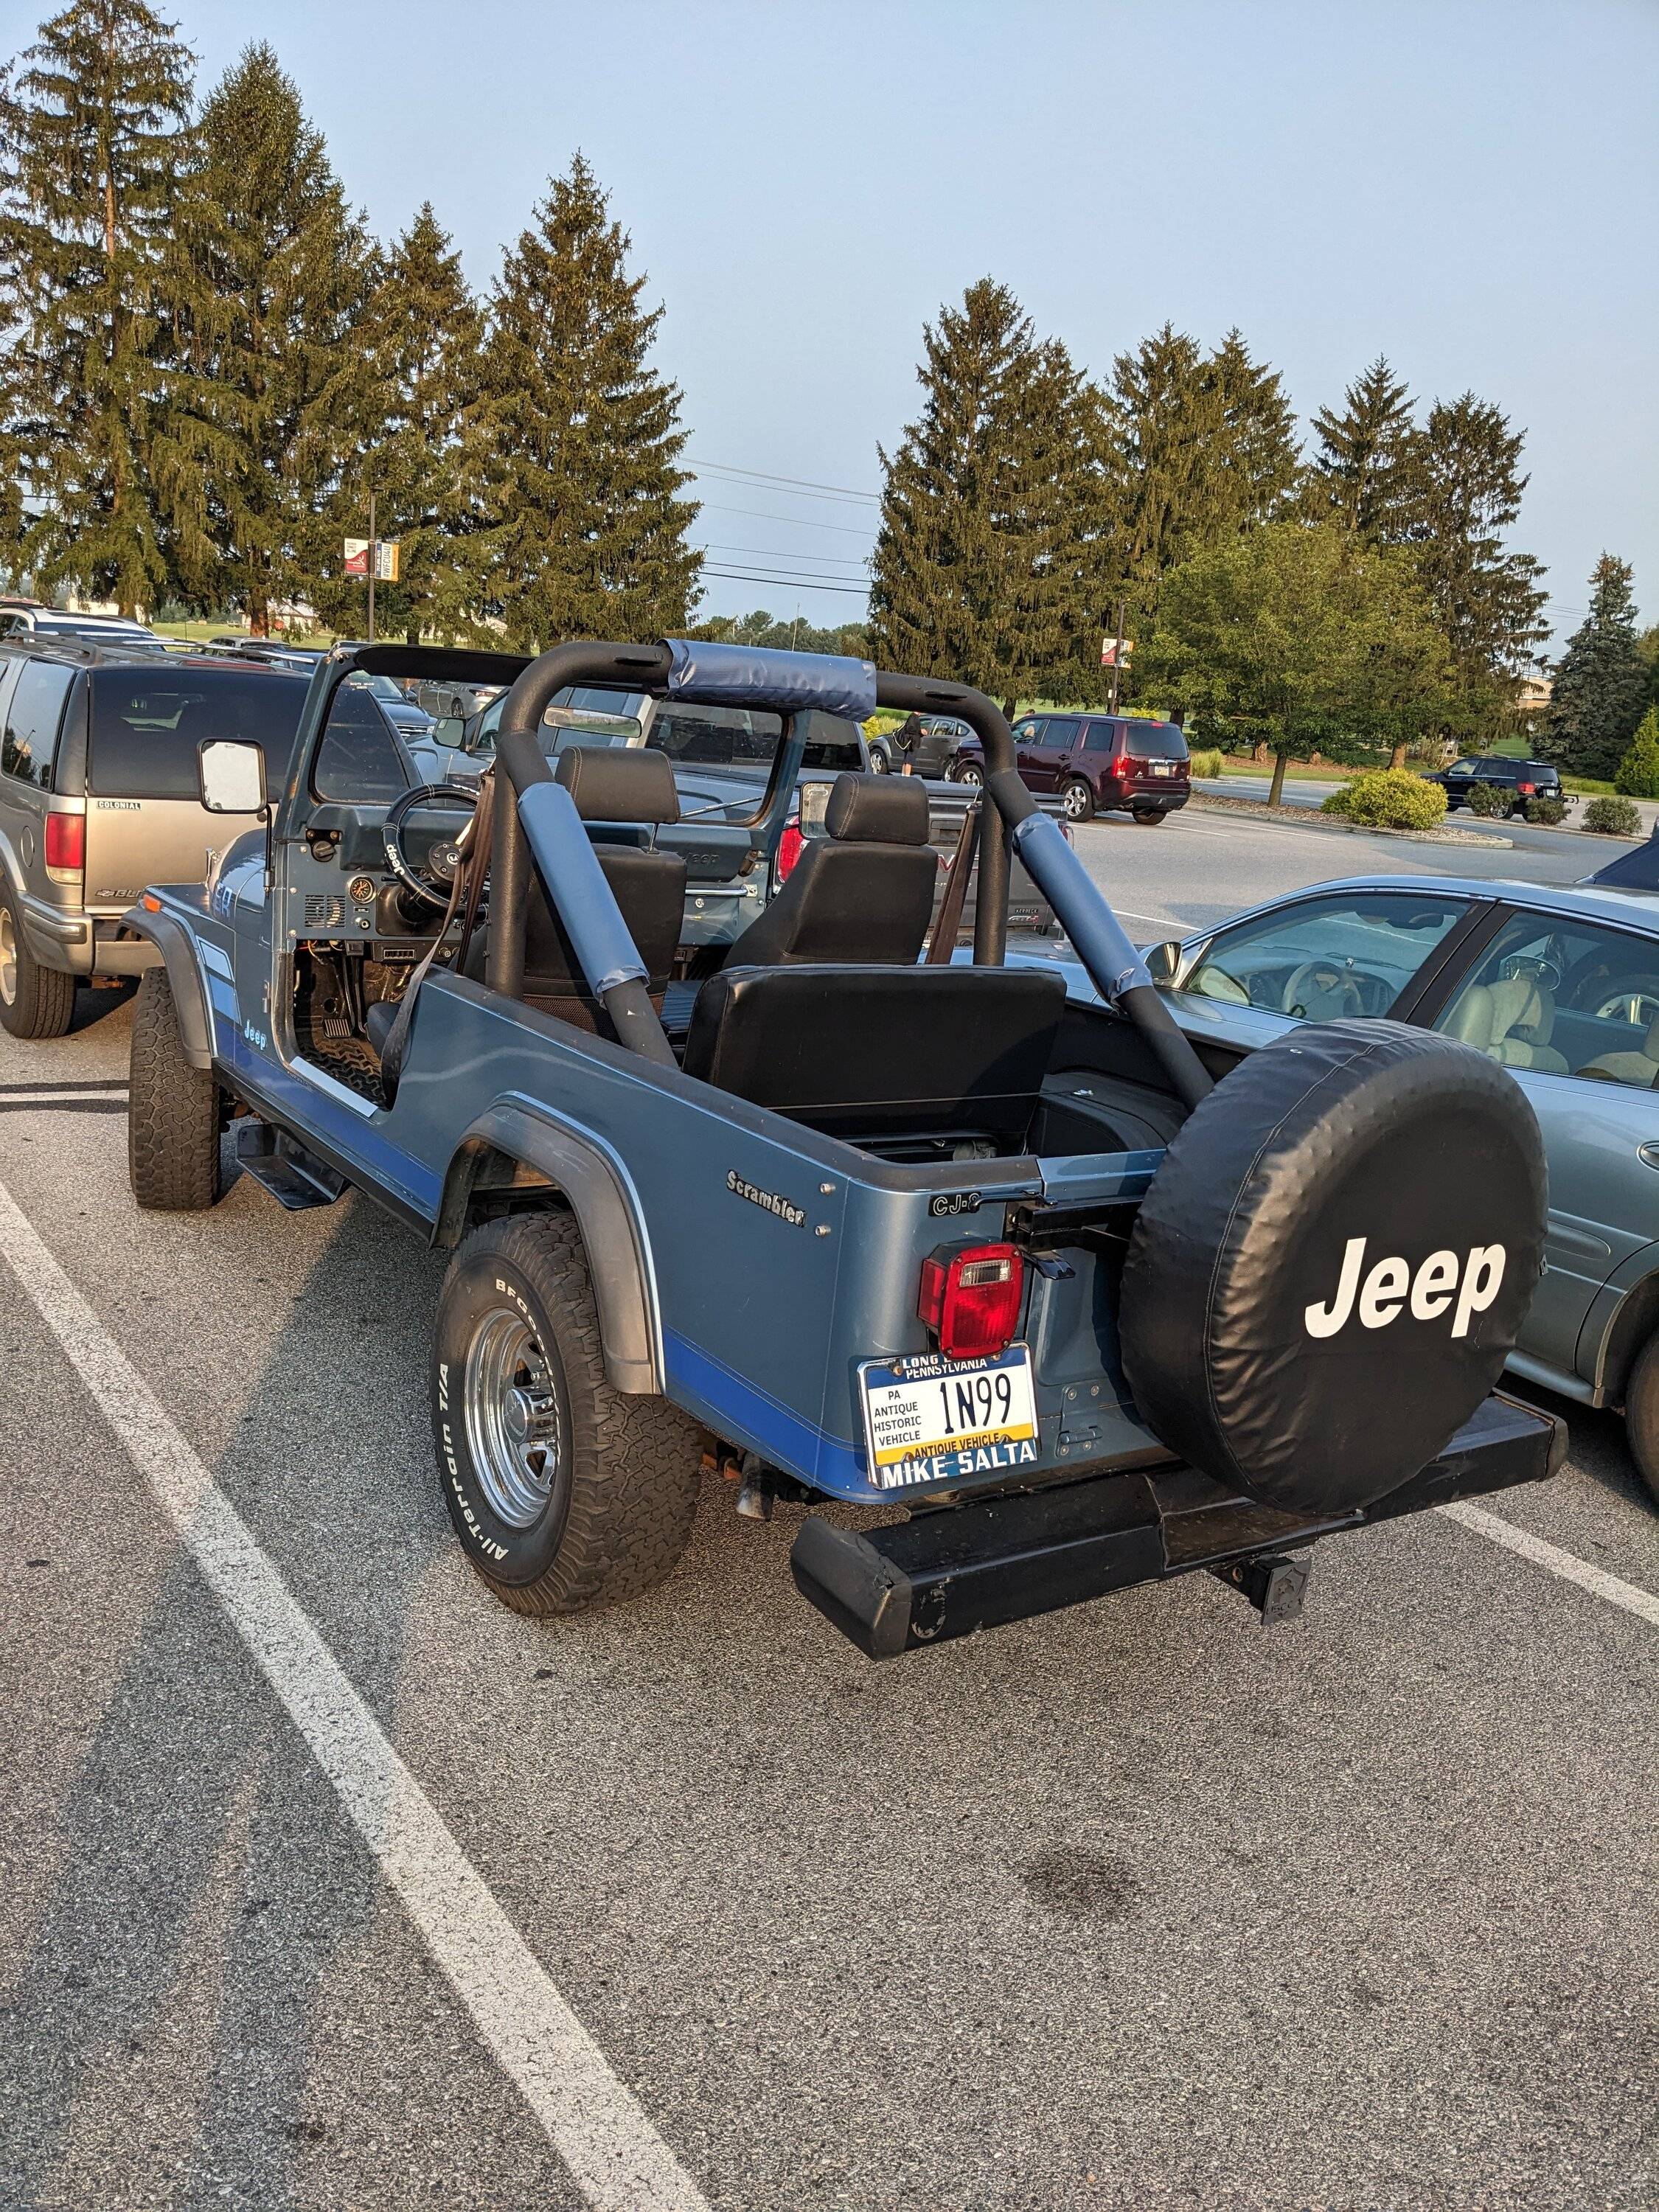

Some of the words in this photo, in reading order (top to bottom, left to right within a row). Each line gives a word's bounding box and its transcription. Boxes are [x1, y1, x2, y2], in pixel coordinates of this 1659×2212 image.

[98, 801, 141, 810] COLONIAL
[386, 844, 406, 876] Jeep
[245, 1019, 266, 1051] Jeep
[726, 1170, 805, 1225] Scrambler
[1304, 1237, 1506, 1338] Jeep
[902, 1354, 939, 1369] LONG
[905, 1358, 988, 1380] PENNSYLVANIA
[439, 1363, 448, 1411] T/A
[888, 1390, 901, 1400] PA
[874, 1402, 919, 1418] ANTIQUE
[939, 1373, 1011, 1434] 1N99
[874, 1416, 922, 1433] HISTORIC
[879, 1430, 921, 1447] VEHICLE
[914, 1443, 957, 1459] ANTIQUE
[959, 1433, 1001, 1450] VEHICLE
[882, 1455, 948, 1489] MIKE
[958, 1440, 1036, 1475] SALTA
